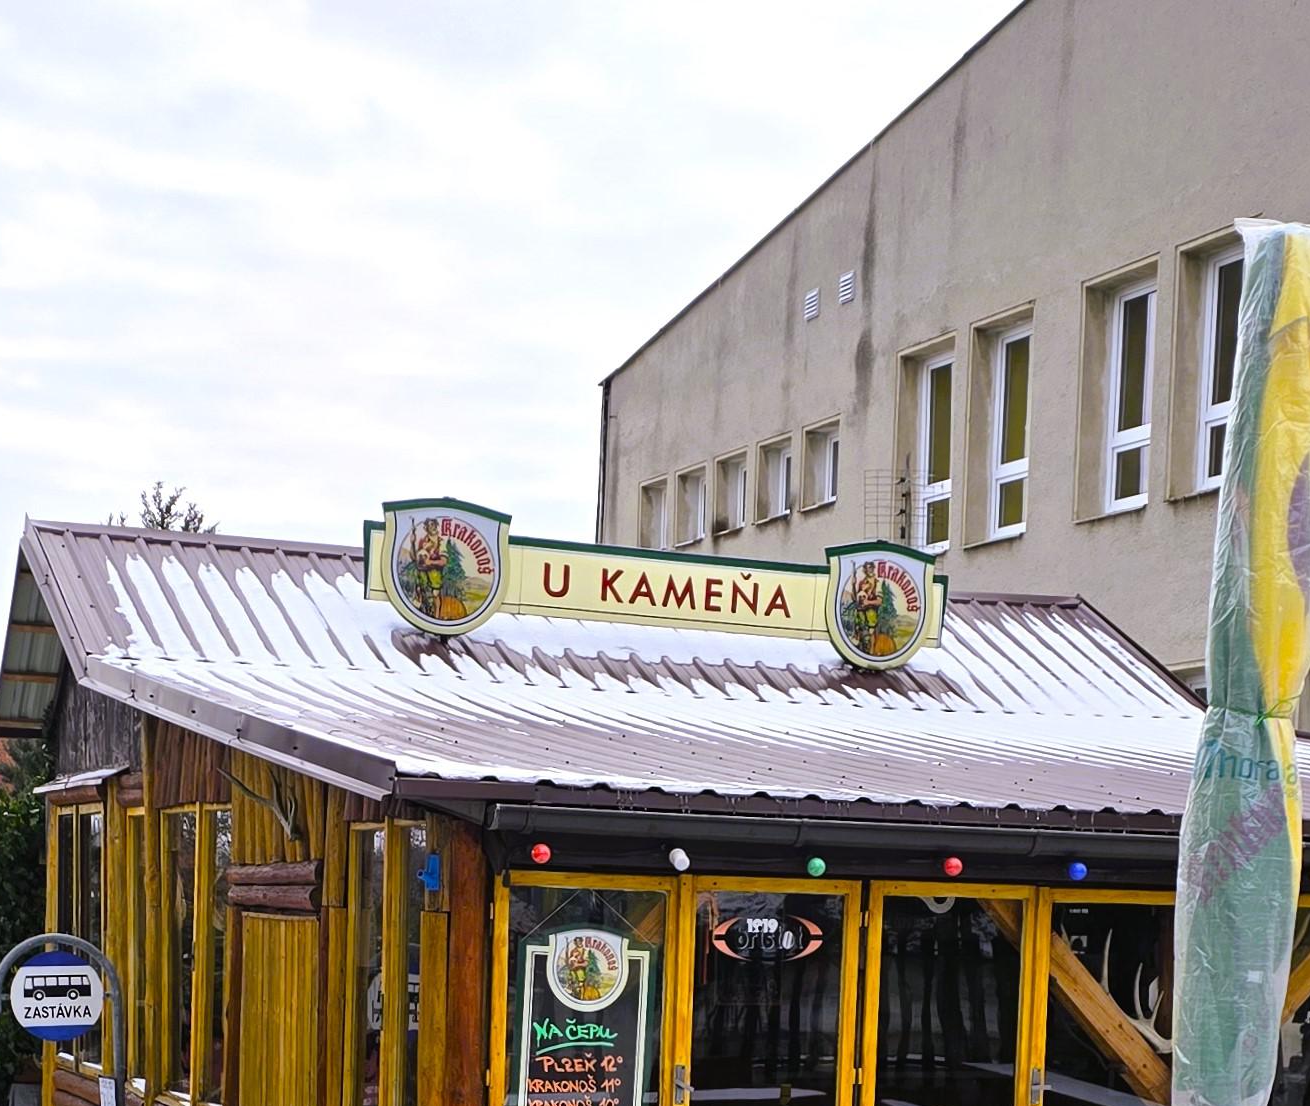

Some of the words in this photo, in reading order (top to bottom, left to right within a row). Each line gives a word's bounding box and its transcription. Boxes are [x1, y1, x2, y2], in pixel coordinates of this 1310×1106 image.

[543, 562, 570, 598] U
[600, 567, 791, 618] KAMEŇA
[24, 1003, 92, 1019] ZASTÁVKA
[533, 1017, 563, 1048] NA
[565, 1018, 618, 1041] ČEPU
[535, 1052, 597, 1073] PLZEŇ
[600, 1055, 624, 1072] 12°
[526, 1074, 597, 1093] KRAKONOŠ
[601, 1078, 621, 1093] 11°
